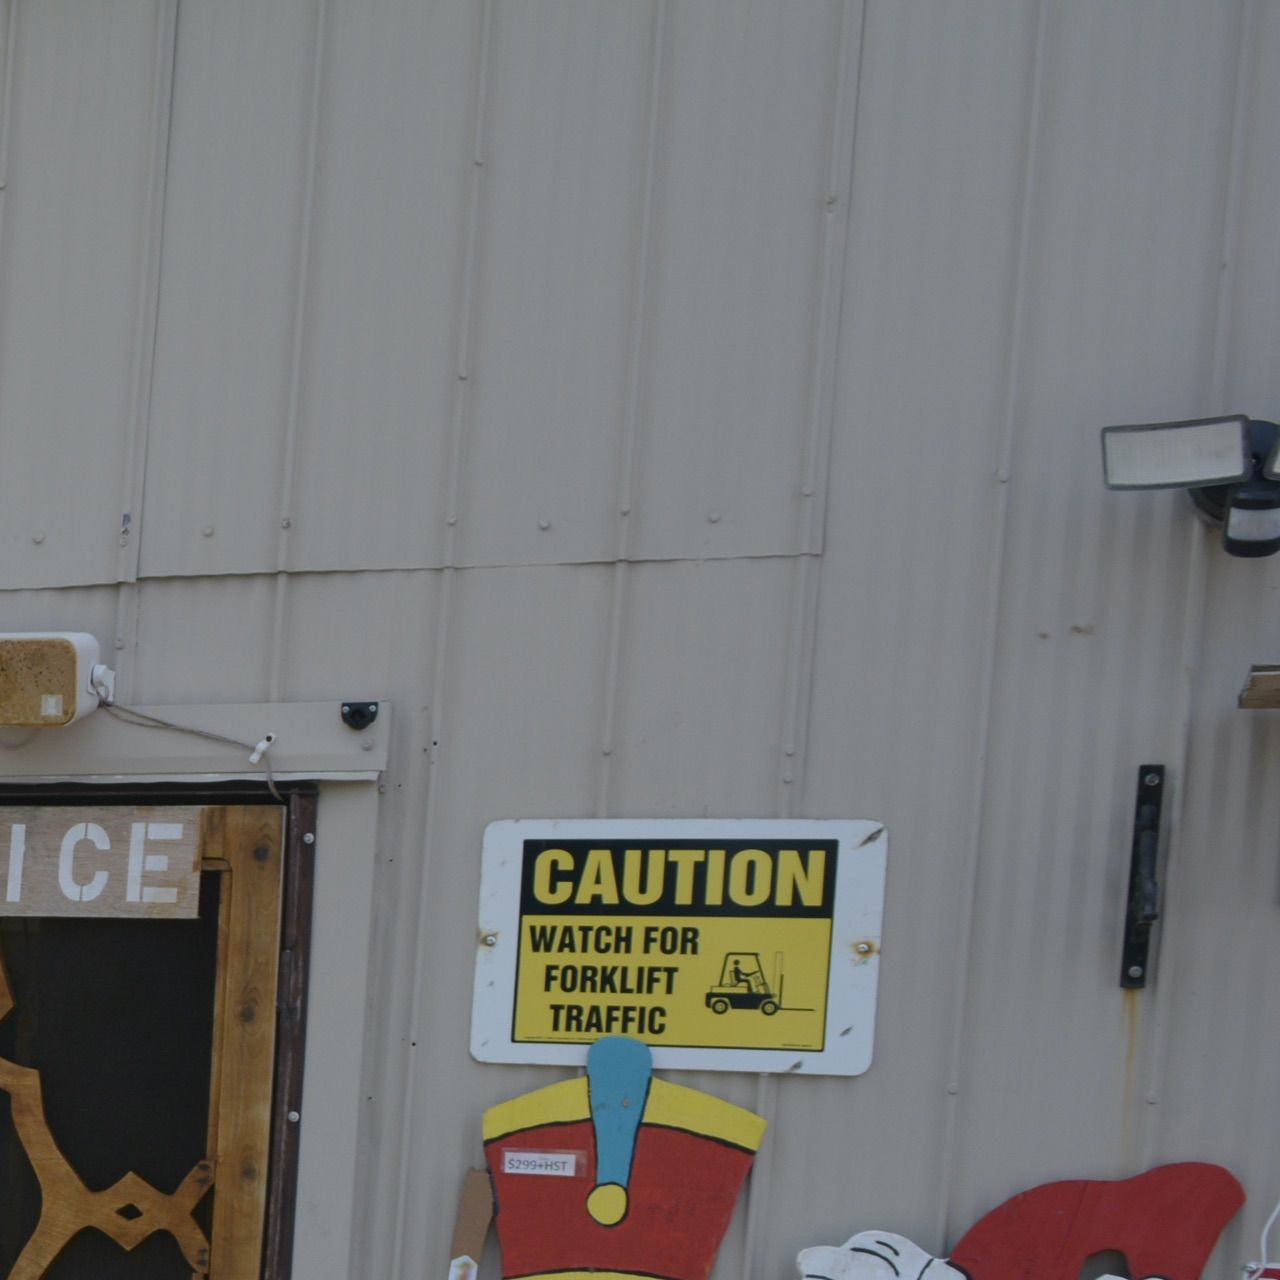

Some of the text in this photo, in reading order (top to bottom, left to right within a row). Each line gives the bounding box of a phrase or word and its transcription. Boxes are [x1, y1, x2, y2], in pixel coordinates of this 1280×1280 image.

[532, 848, 828, 907] CAUTION
[529, 925, 700, 956] WATCH FOR
[544, 965, 679, 995] FORKLIFT
[549, 1004, 667, 1035] TRAFFIC
[507, 1158, 569, 1172] $299+HST
